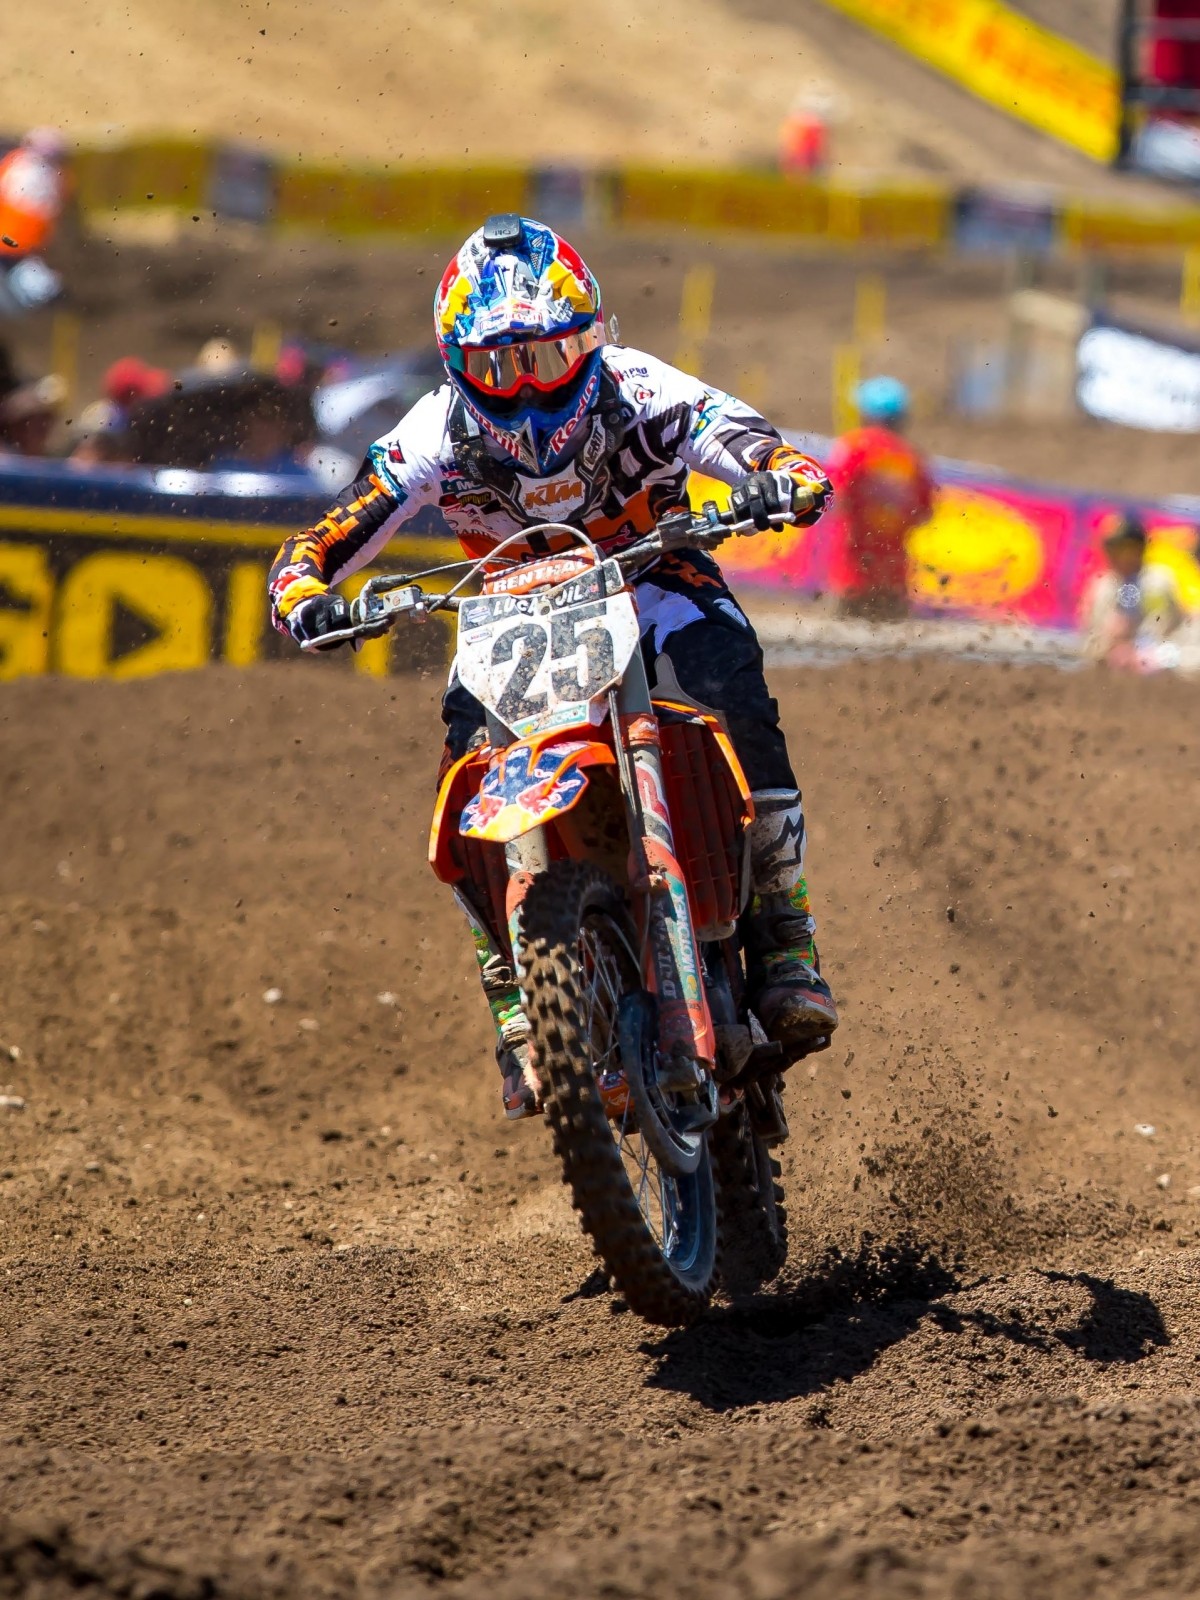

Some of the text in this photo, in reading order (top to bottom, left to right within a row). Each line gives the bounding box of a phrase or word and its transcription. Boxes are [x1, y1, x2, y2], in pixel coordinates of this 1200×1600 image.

[525, 479, 583, 510] KTM
[494, 558, 588, 594] RENTHAL
[491, 601, 616, 725] 25
[676, 890, 696, 977] MOTOREX
